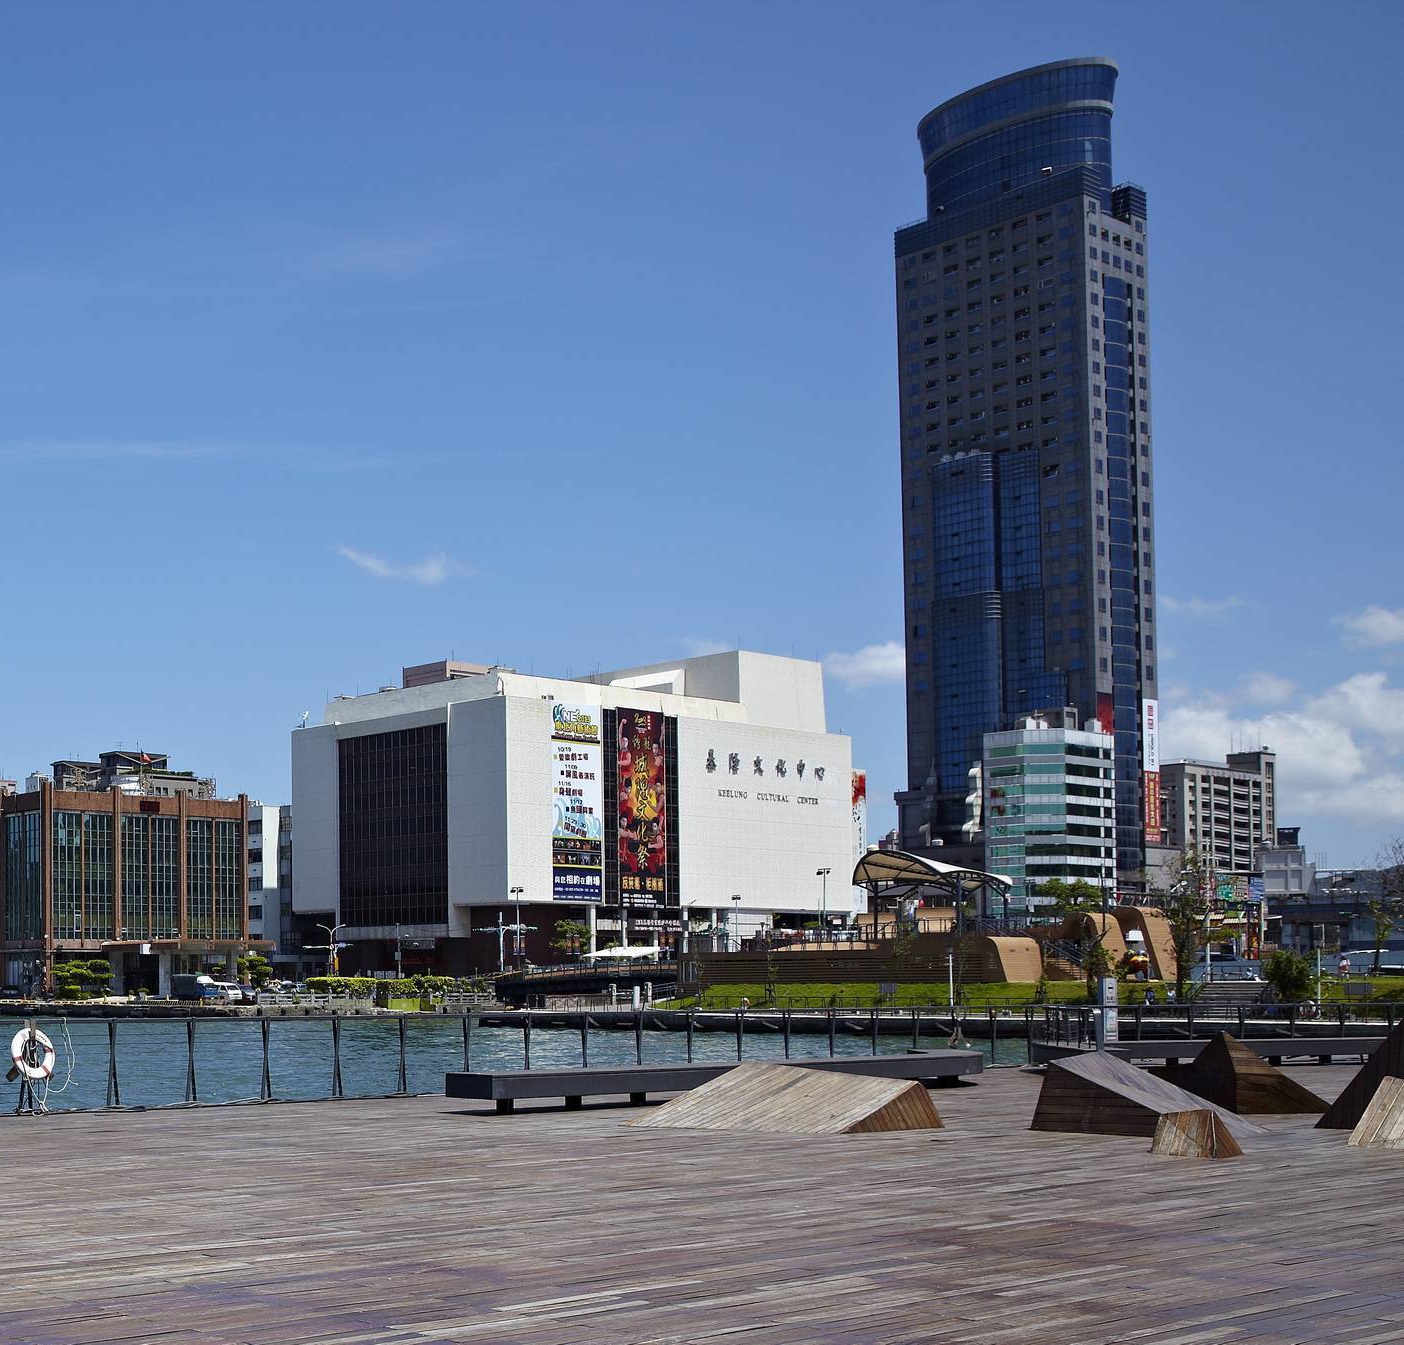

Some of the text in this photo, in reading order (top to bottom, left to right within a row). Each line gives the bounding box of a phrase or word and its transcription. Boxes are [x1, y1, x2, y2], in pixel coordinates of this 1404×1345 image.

[705, 748, 825, 781] 基隆文化中心
[717, 789, 819, 805] KEELUNG CULTURAL CENTER
